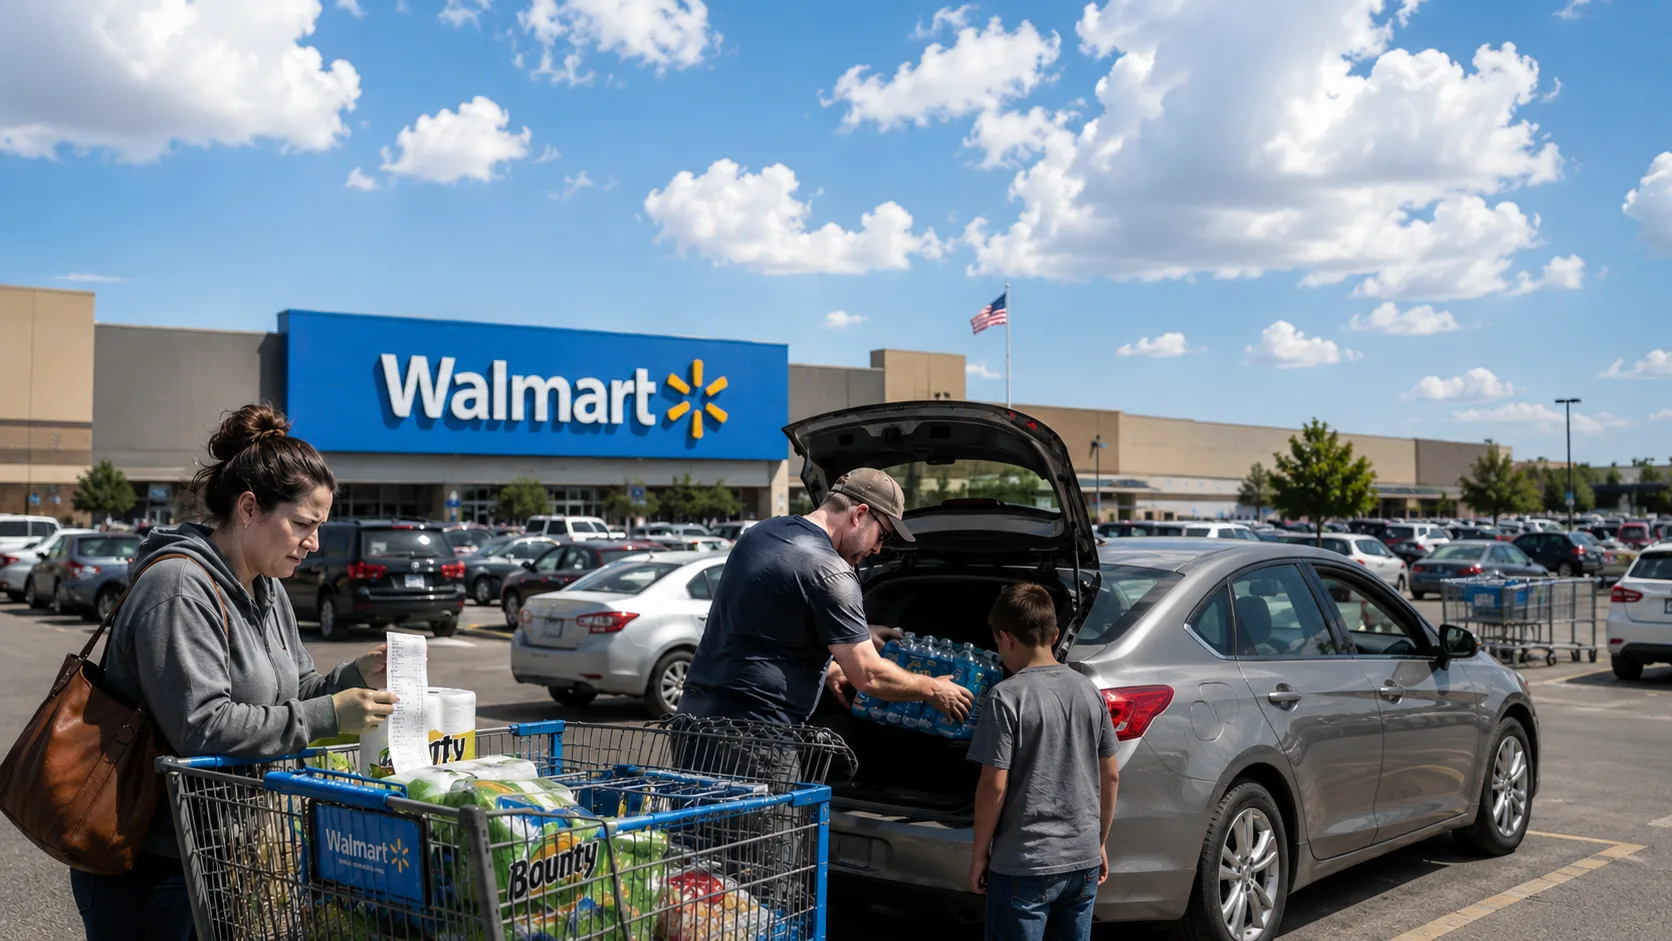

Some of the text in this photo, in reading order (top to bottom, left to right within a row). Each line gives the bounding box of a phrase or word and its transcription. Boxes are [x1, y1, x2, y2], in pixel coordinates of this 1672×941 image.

[380, 353, 656, 426] Walmart
[326, 828, 388, 864] Walmart
[507, 840, 599, 901] Bounty
